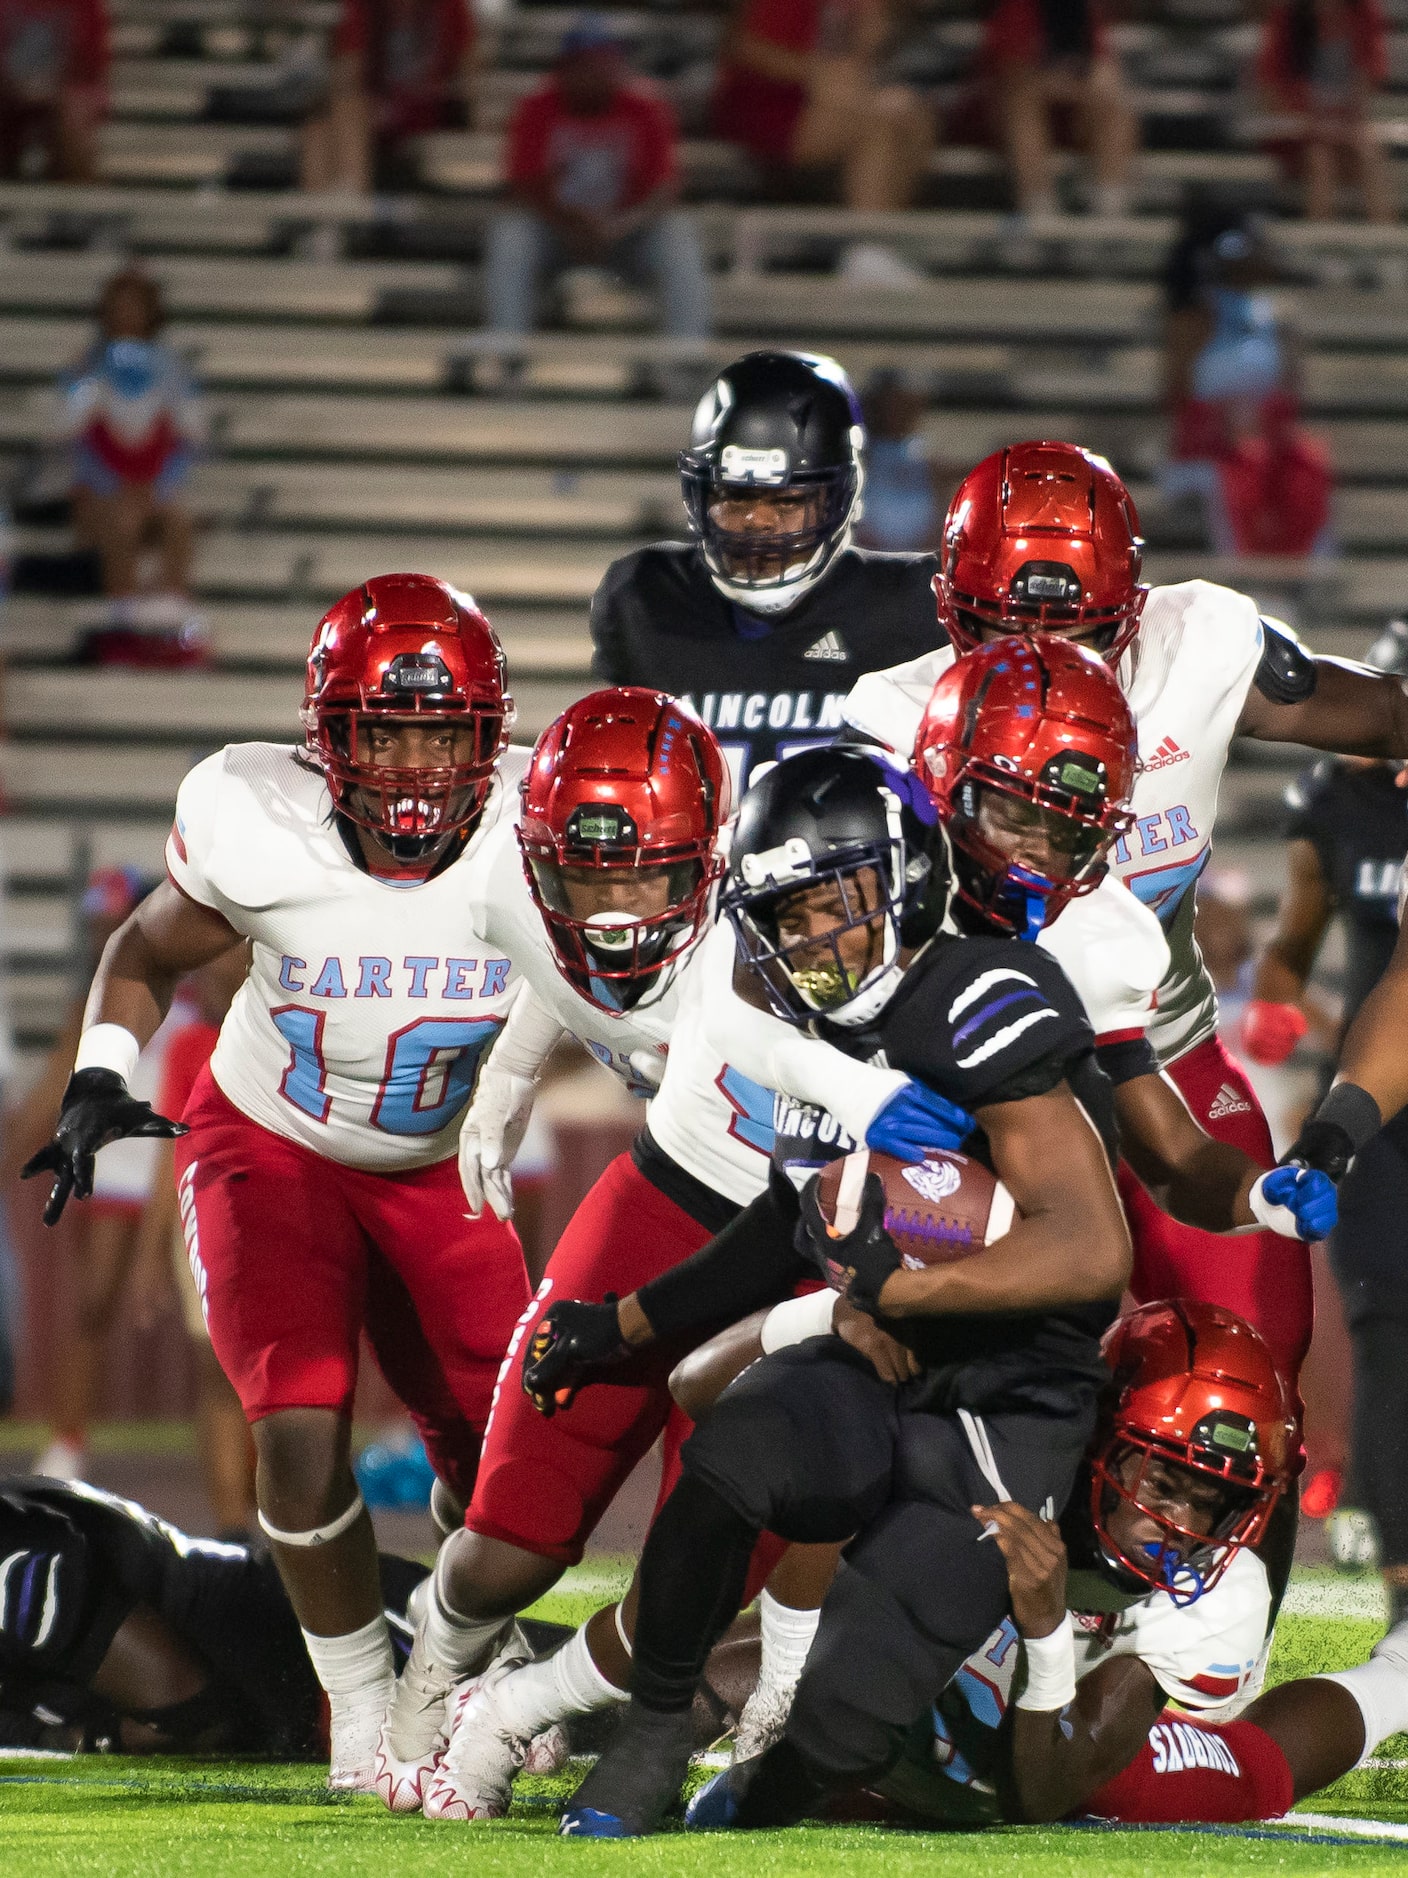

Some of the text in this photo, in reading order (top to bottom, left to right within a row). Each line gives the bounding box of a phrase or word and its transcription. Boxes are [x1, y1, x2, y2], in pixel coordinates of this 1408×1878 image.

[804, 649, 847, 661] adidas
[1143, 750, 1191, 773] adidas
[1114, 804, 1199, 865] TER
[279, 954, 512, 999] CARTER
[269, 1003, 509, 1137] 10
[1208, 1101, 1251, 1119] adidas
[1148, 1721, 1240, 1778] COWBOYS
